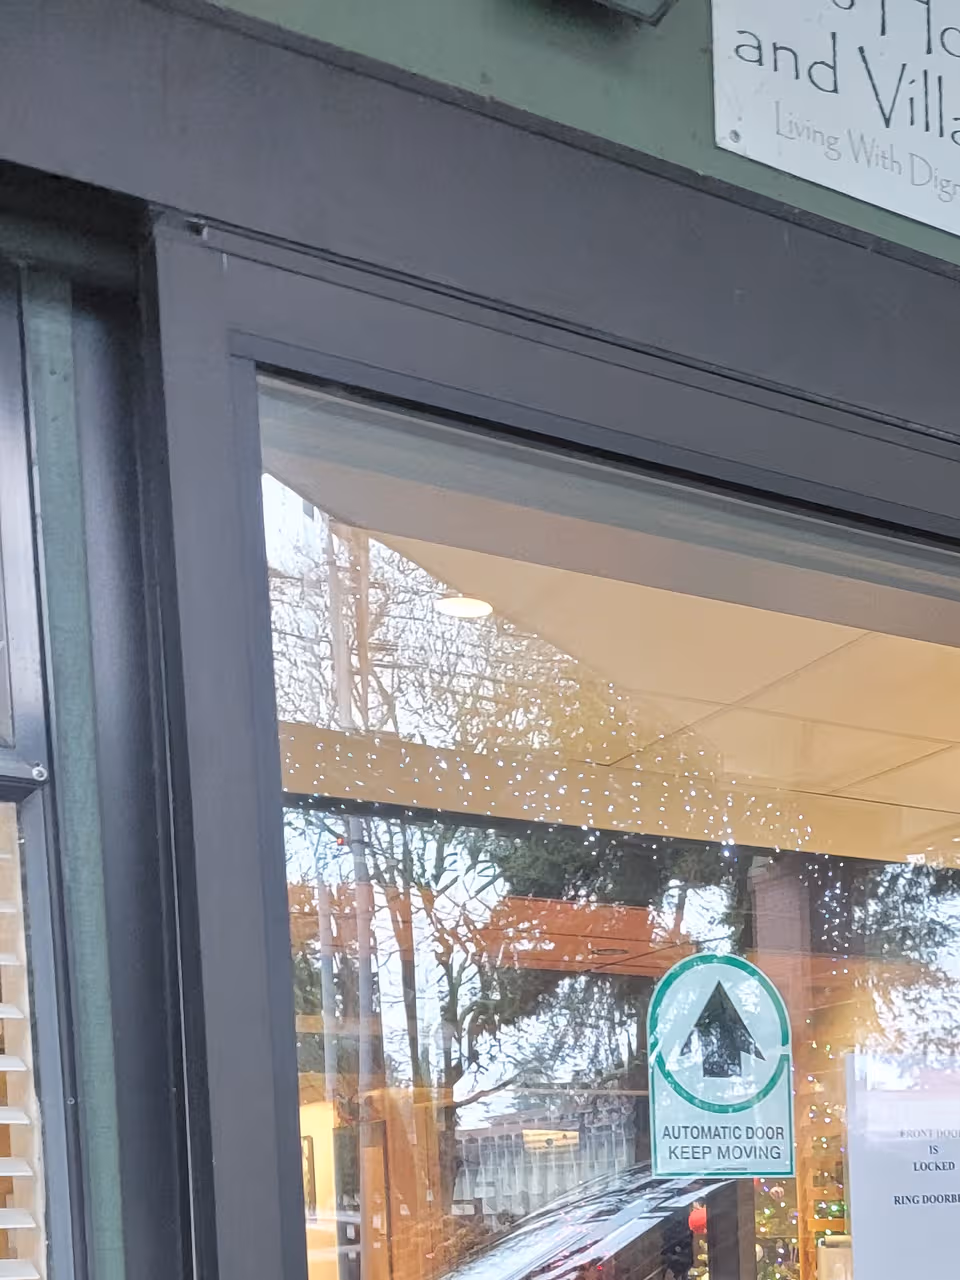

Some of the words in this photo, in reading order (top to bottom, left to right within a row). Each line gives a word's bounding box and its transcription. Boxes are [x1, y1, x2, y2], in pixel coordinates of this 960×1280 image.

[734, 30, 839, 94] and
[775, 100, 842, 161] Living
[847, 128, 903, 176] With
[662, 1125, 742, 1140] AUTOMATIC
[745, 1126, 785, 1140] DOOR
[900, 1129, 934, 1139] FRONT
[668, 1145, 712, 1160] KEEP
[717, 1145, 781, 1160] MOVING
[928, 1145, 939, 1155] IS
[913, 1161, 955, 1171] LOCKED
[894, 1195, 920, 1205] RING
